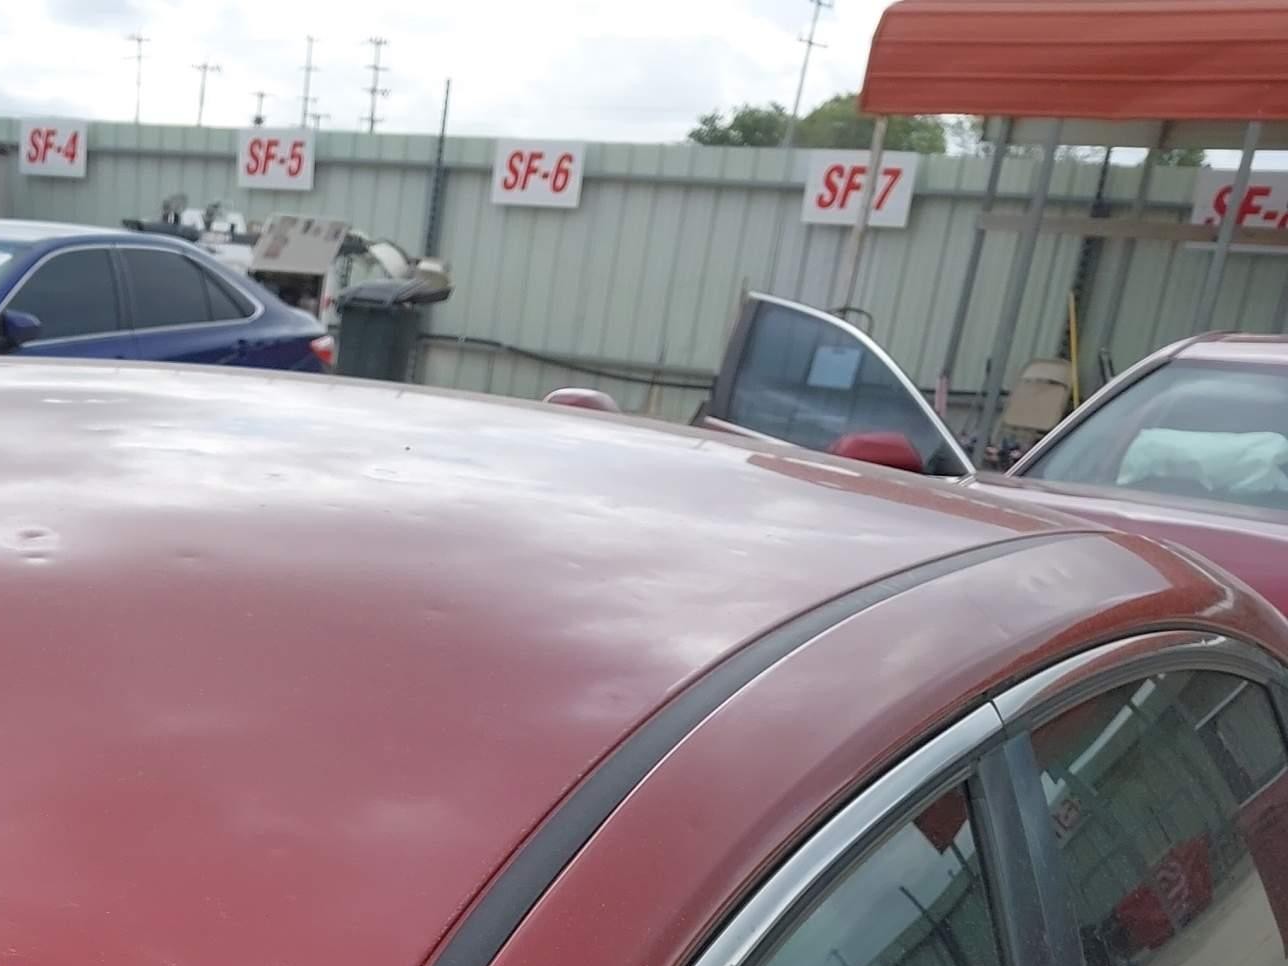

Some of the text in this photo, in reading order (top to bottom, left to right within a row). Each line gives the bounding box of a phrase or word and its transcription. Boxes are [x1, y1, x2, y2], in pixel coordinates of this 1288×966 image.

[27, 127, 79, 164] SF-4
[246, 138, 306, 178] SF-5
[502, 151, 575, 193] SF-6
[816, 163, 904, 211] SF7
